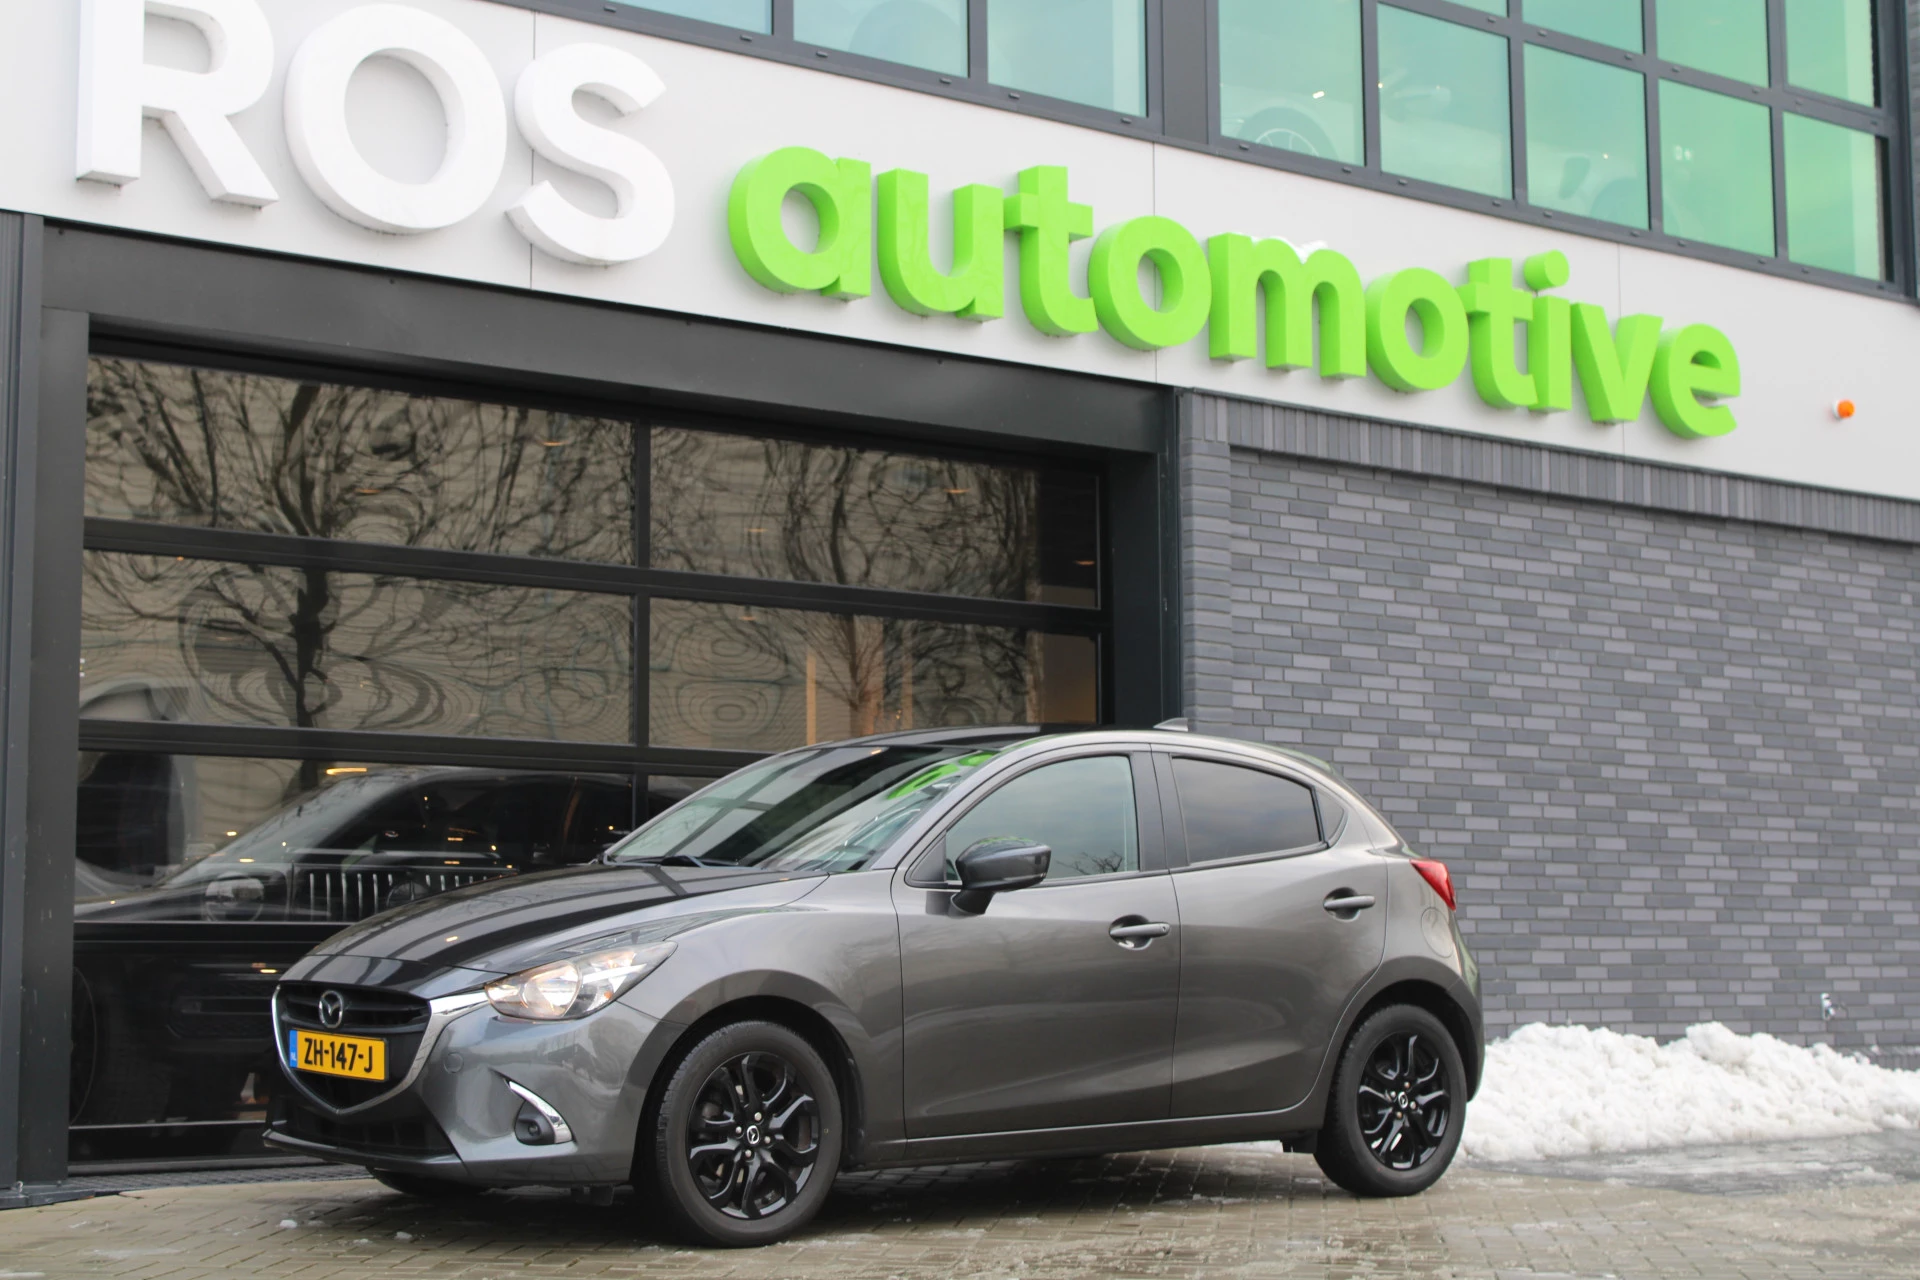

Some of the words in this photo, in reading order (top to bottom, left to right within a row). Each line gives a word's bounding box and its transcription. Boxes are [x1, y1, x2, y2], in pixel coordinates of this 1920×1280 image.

[75, 0, 676, 266] ROS
[727, 145, 1741, 439] automotive
[304, 1038, 373, 1073] ZH-147-J
